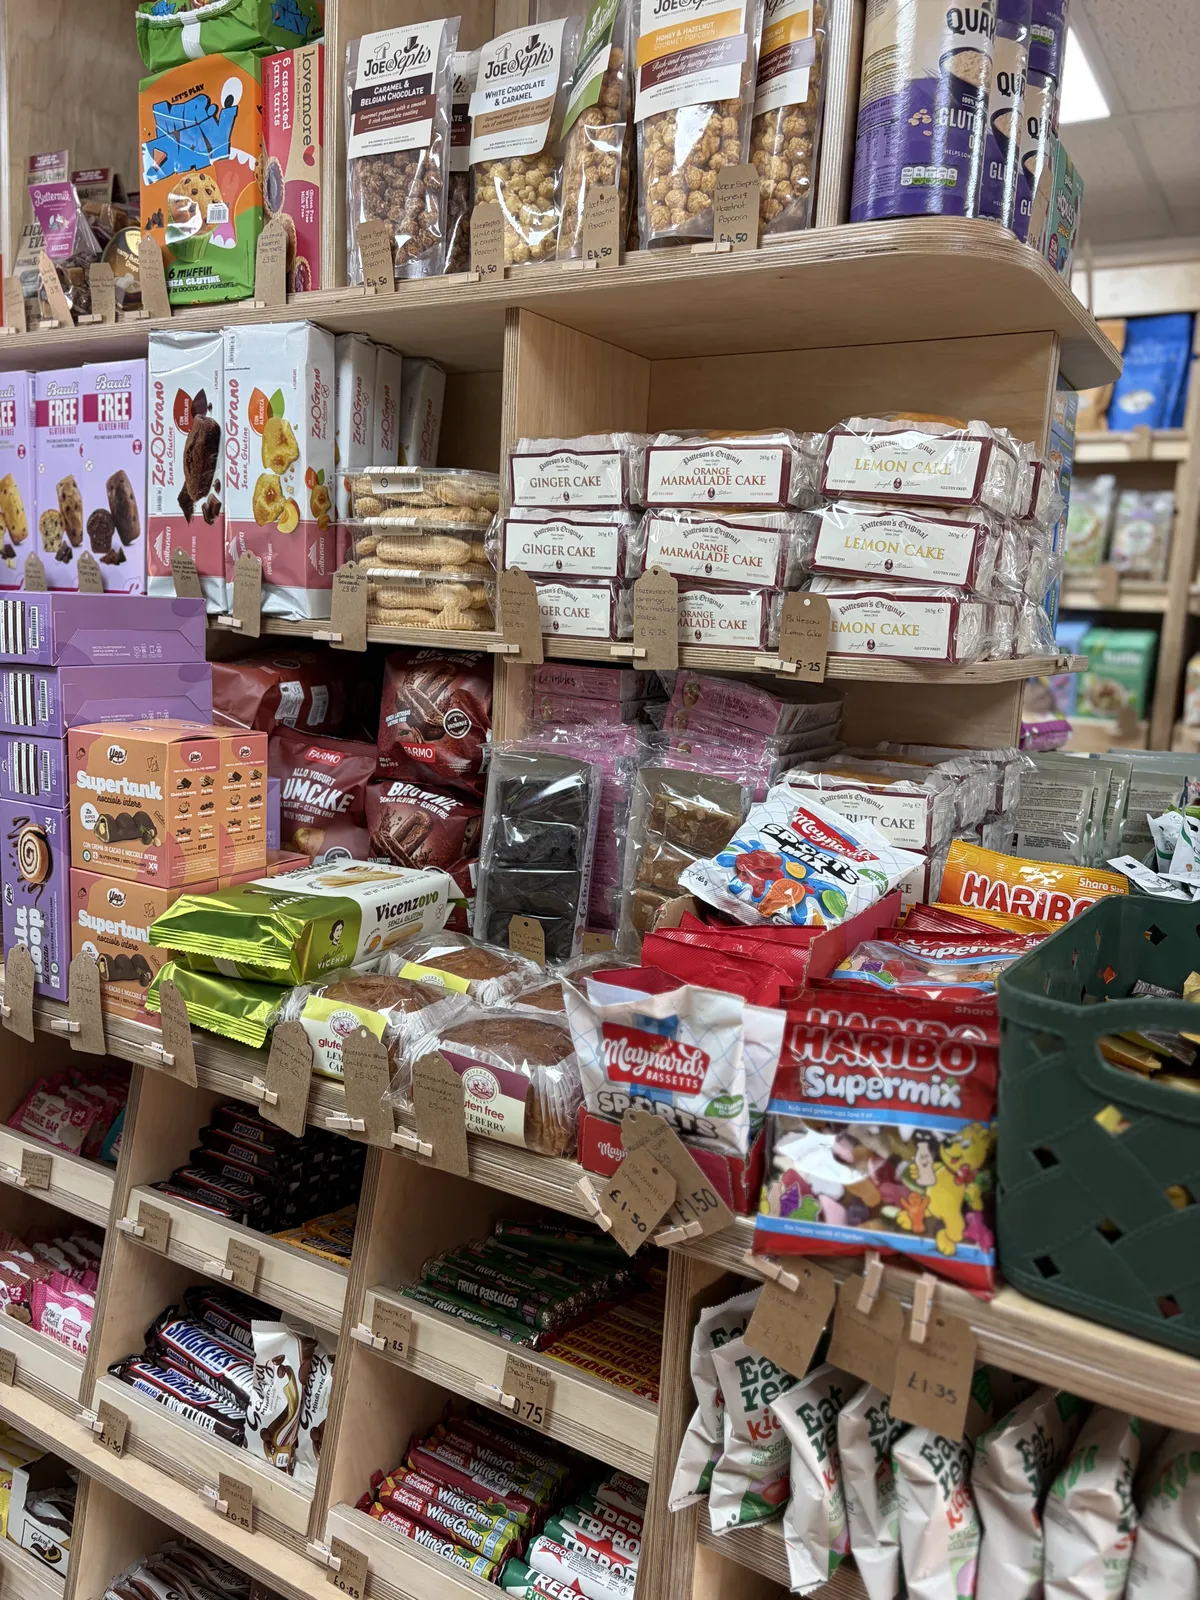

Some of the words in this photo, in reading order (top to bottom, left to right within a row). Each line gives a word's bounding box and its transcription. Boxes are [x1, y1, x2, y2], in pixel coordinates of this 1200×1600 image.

[654, 39, 683, 50] GOURMET
[684, 29, 715, 42] POPCORN
[656, 32, 676, 41] HONEY
[683, 22, 715, 35] HAZELNUT
[281, 57, 291, 67] 6
[271, 60, 282, 89] jam
[171, 88, 187, 103] LET'S
[188, 83, 205, 99] PLAY
[374, 83, 402, 94] CARAMEL
[404, 80, 409, 88] &
[485, 89, 506, 100] WHITE
[507, 79, 545, 94] CHOCOLATE
[281, 70, 291, 131] assorted
[301, 49, 316, 147] lovemore
[360, 92, 386, 106] BELGIAN
[387, 87, 424, 100] CHOCOLATE
[501, 92, 532, 105] CARAMEL
[273, 91, 282, 126] tarts
[360, 112, 377, 121] Gourmet
[378, 107, 395, 117] popcorn
[411, 99, 427, 108] smooth
[381, 113, 402, 122] chocolate
[404, 109, 418, 118] coating
[484, 112, 503, 122] Gourmet
[503, 108, 520, 119] popcorn
[521, 106, 530, 114] with
[34, 189, 72, 206] Buttermilk
[718, 213, 748, 223] Popcorn
[587, 247, 613, 260] £4.50
[168, 269, 175, 278] 6
[176, 266, 212, 277] MUFFIN
[46, 381, 79, 396] Bauli
[96, 374, 132, 390] Bauli
[48, 398, 77, 427] FREE
[98, 392, 130, 421] FREE
[49, 427, 64, 435] GLUTEN
[65, 426, 77, 434] FREE
[98, 423, 116, 431] GLUTEN
[117, 422, 130, 430] FREE
[166, 426, 174, 459] Glutine
[166, 461, 175, 487] Senza
[693, 467, 731, 476] ORANGE
[854, 458, 908, 473] LEMON
[912, 461, 952, 476] CAKE
[529, 476, 571, 488] GINGER
[573, 475, 602, 487] CAKE
[660, 474, 732, 487] MARMALADE
[735, 474, 767, 486] CAKE
[859, 519, 897, 532] Patteson's
[898, 520, 929, 540] Original
[162, 526, 172, 567] Galbusera
[522, 543, 565, 556] GINGER
[567, 545, 597, 558] CAKE
[692, 541, 729, 553] ORANGE
[843, 536, 901, 554] LEMON
[903, 544, 945, 561] CAKE
[659, 546, 730, 563] MARMALADE
[732, 554, 764, 568] CAKE
[563, 607, 590, 618] CAKE
[680, 611, 714, 619] ORANGE
[839, 599, 875, 616] Patteson's
[875, 601, 905, 618] Original
[831, 622, 875, 633] EMON
[880, 623, 920, 637] CAKE
[307, 749, 342, 764] FARMO
[404, 746, 433, 759] FARMO
[76, 771, 163, 800] Supertank
[292, 768, 308, 778] ALLO
[309, 771, 336, 787] YOGURT
[97, 794, 122, 807] nocciole
[123, 797, 142, 809] intere
[820, 793, 853, 805] Patteson's
[855, 794, 884, 810] Original
[437, 808, 450, 820] FREE
[881, 817, 915, 829] CAKE
[82, 841, 91, 849] CON
[124, 849, 143, 859] NOCCIOLE
[144, 854, 157, 862] INTERE
[760, 824, 860, 884] SPORTS
[779, 844, 831, 877] MIX
[148, 863, 158, 871] X4
[1078, 876, 1109, 891] Share
[1110, 885, 1125, 894] Size
[375, 890, 440, 922] Vicenzovo
[388, 916, 404, 928] SENZA
[404, 909, 425, 922] GLUTINE
[96, 934, 121, 948] nocciole
[122, 939, 139, 951] intere
[316, 955, 348, 971] VICENZI
[954, 1005, 994, 1017] Share
[601, 1037, 707, 1080] Maynards
[790, 1024, 978, 1076] HARIBO
[646, 1071, 699, 1089] BASSETTS
[802, 1066, 962, 1110] Supermix
[788, 1104, 801, 1113] Kids
[802, 1107, 812, 1115] and
[814, 1107, 846, 1119] grown-ups
[847, 1110, 859, 1118] love
[233, 1124, 261, 1139] SNICKERS
[467, 1124, 494, 1138] CAKE
[608, 1189, 648, 1233] £1.50
[674, 1188, 719, 1223] £1.50
[165, 1321, 237, 1368] SNICKERS
[907, 1370, 958, 1405] £1.35
[795, 1384, 843, 1438] Eat
[99, 1428, 121, 1454] £1.50
[436, 1446, 465, 1465] Bassetts
[469, 1457, 524, 1494] WineGums
[411, 1472, 435, 1487] Maynards
[399, 1487, 423, 1504] Maynards
[404, 1476, 434, 1495] Bassetts
[437, 1487, 493, 1527] WineGums
[387, 1511, 411, 1528] Maynards
[393, 1492, 422, 1512] Bassetts
[426, 1502, 483, 1547] WineGums
[380, 1515, 410, 1536] Bassetts
[414, 1526, 470, 1569] WineGums
[538, 1537, 572, 1560] TREBOR
